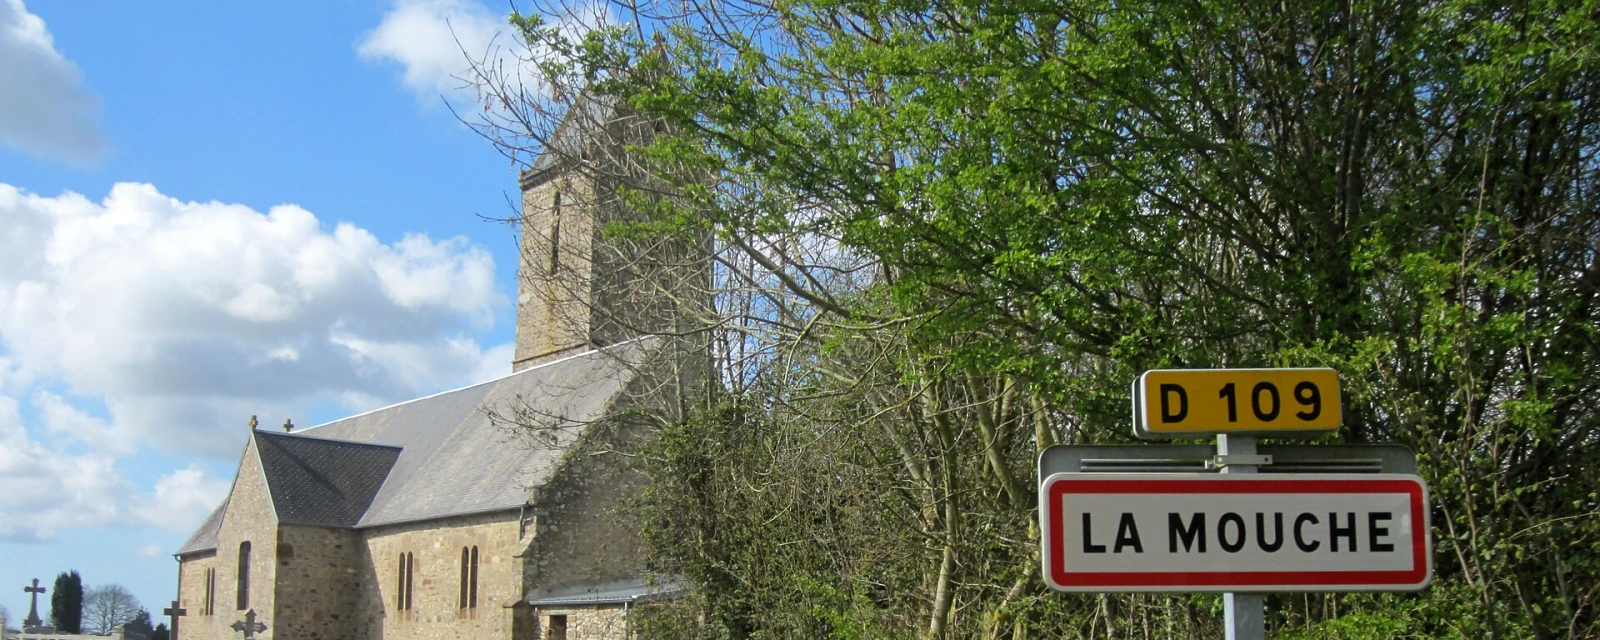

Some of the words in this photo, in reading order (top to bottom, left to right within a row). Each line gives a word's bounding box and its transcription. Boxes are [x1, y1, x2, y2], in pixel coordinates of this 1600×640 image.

[1160, 383, 1189, 424] D
[1218, 381, 1322, 423] 109
[1082, 512, 1144, 554] LA
[1168, 511, 1395, 554] MOUCHE
